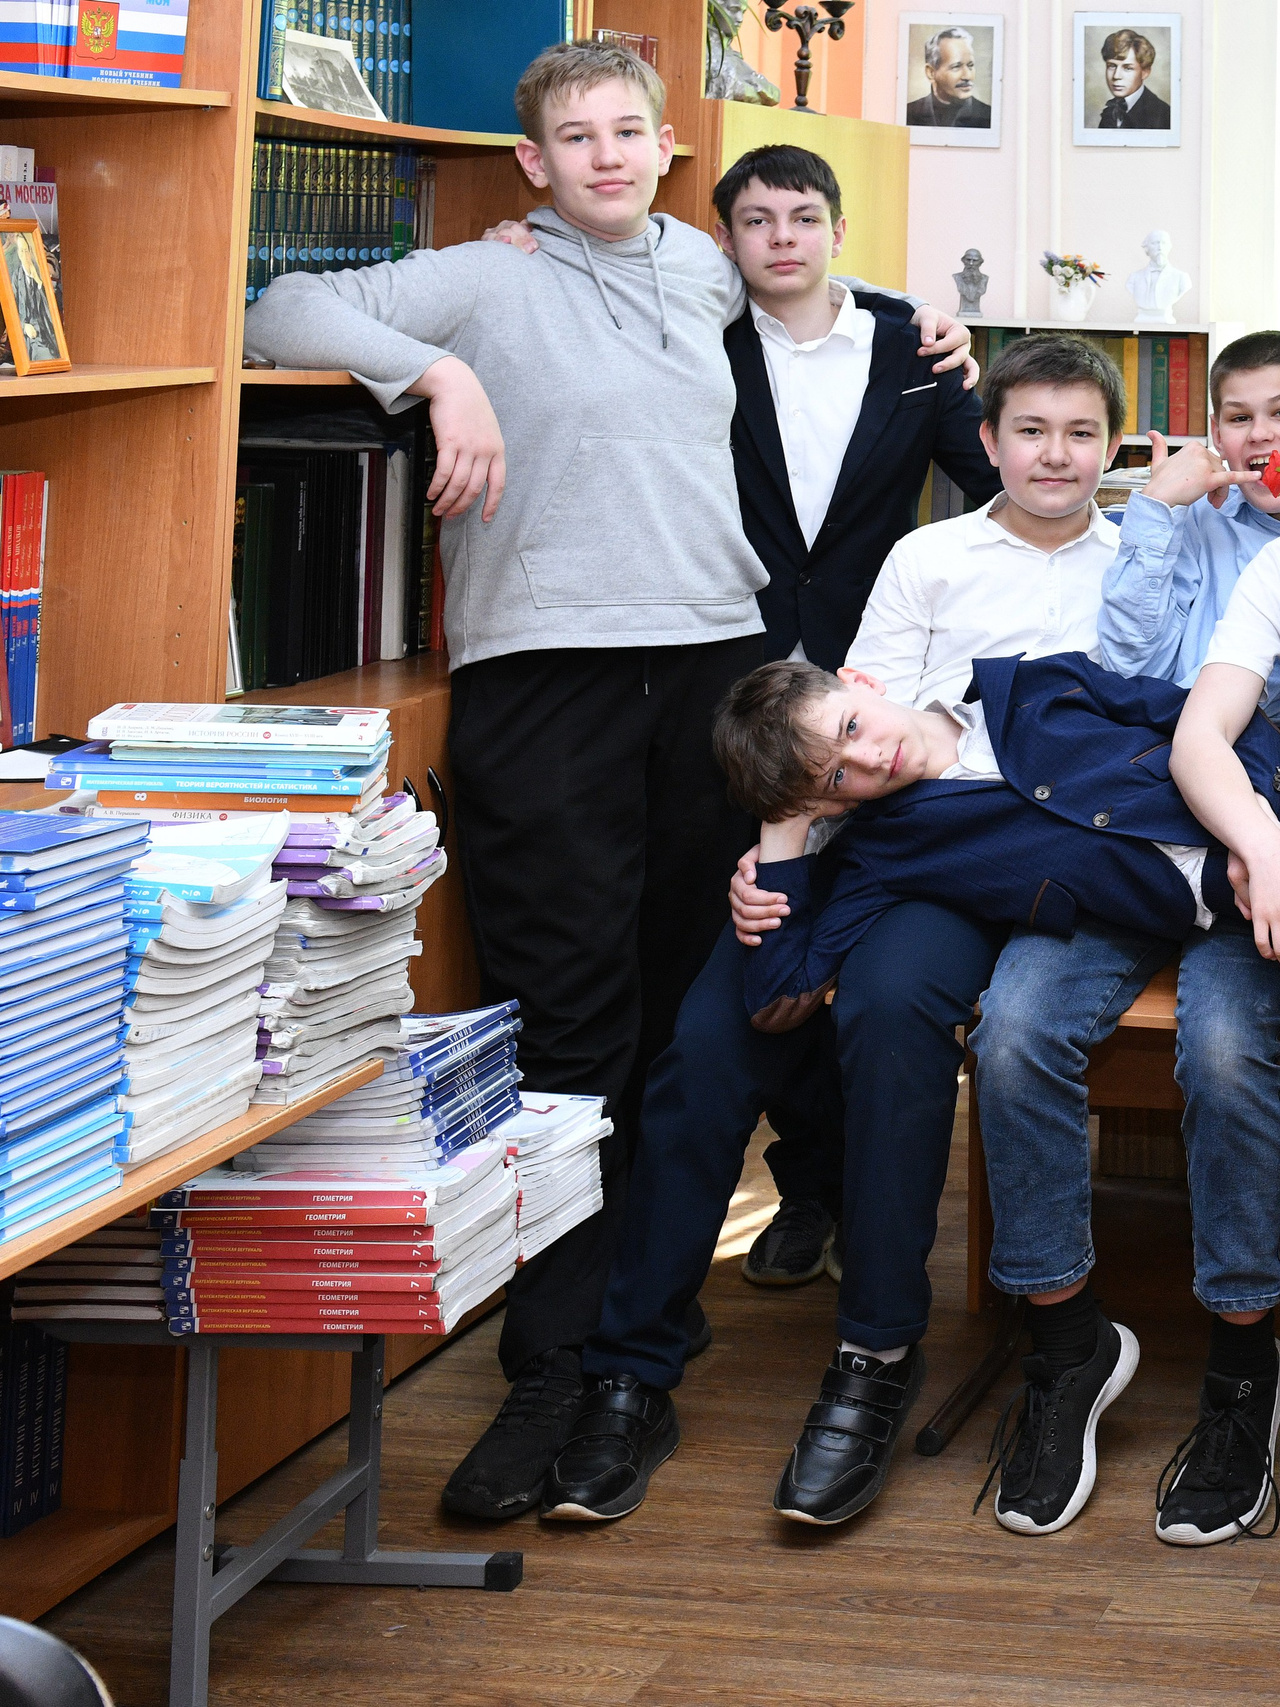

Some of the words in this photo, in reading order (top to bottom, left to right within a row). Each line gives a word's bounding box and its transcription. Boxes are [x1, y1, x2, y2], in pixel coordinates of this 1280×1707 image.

[99, 69, 123, 78] НОВЫЙ
[124, 70, 154, 79] УЧЕБНИК
[15, 184, 54, 205] МОСКВУ
[188, 730, 223, 738] ИСТОРИЯ
[225, 731, 259, 739] РОССИИ
[175, 780, 205, 789] ТЕОРИЯ
[206, 780, 263, 790] ВЕРОЯТНОСТЕЙ
[264, 782, 270, 790] И
[271, 782, 318, 791] СТАТИСТИКА
[243, 796, 288, 804] БИОЛОГИЯ
[172, 811, 212, 820] ФИЗИКА
[448, 1025, 473, 1043] ХИМИЯ
[447, 1038, 470, 1057] ХИМИЯ
[312, 1194, 353, 1203] ГЕОМЕТРИЯ
[412, 1194, 422, 1202] 7
[305, 1213, 346, 1221] ГЕОМЕТРИЯ
[406, 1211, 416, 1219] 7
[313, 1229, 354, 1237] ГЕОМЕТРИЯ
[413, 1229, 422, 1237] 7
[313, 1247, 353, 1256] ГЕОМЕТРИЯ
[412, 1248, 422, 1256] 7
[318, 1260, 359, 1269] ГЕОМЕТРИЯ
[311, 1279, 352, 1288] ГЕОМЕТРИЯ
[318, 1293, 358, 1301] ГЕОМЕТРИЯ
[319, 1308, 360, 1316] ГЕОМЕТРИЯ
[418, 1308, 428, 1316] 7
[323, 1322, 364, 1330] ГЕОМЕТРИЯ
[424, 1322, 433, 1330] 7
